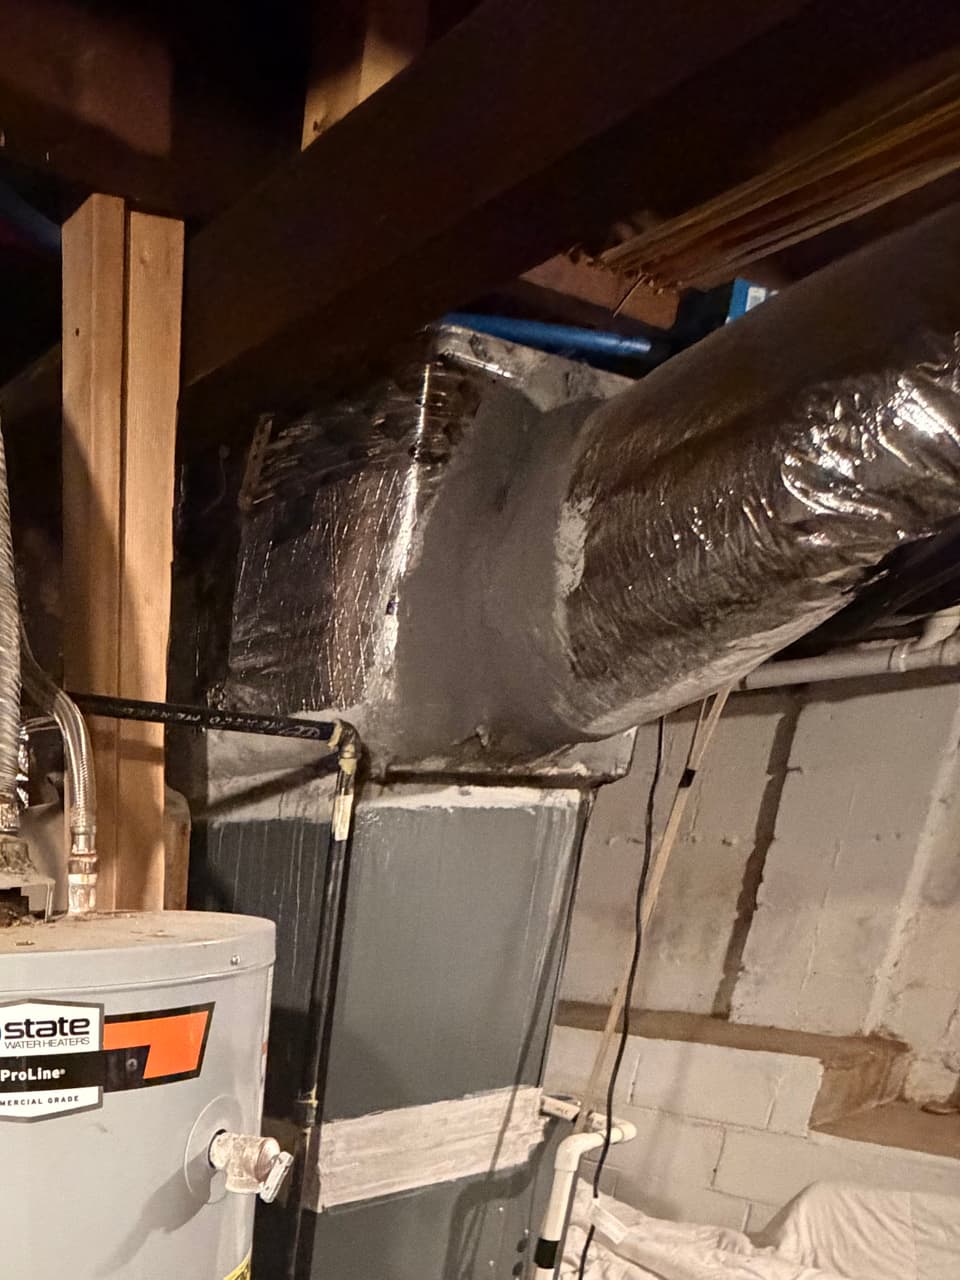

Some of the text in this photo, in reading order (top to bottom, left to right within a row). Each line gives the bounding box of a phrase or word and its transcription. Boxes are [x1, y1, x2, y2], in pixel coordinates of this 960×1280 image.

[4, 1017, 90, 1039] state
[4, 1037, 90, 1049] WATER HEATERS
[48, 1096, 79, 1104] GRADE
